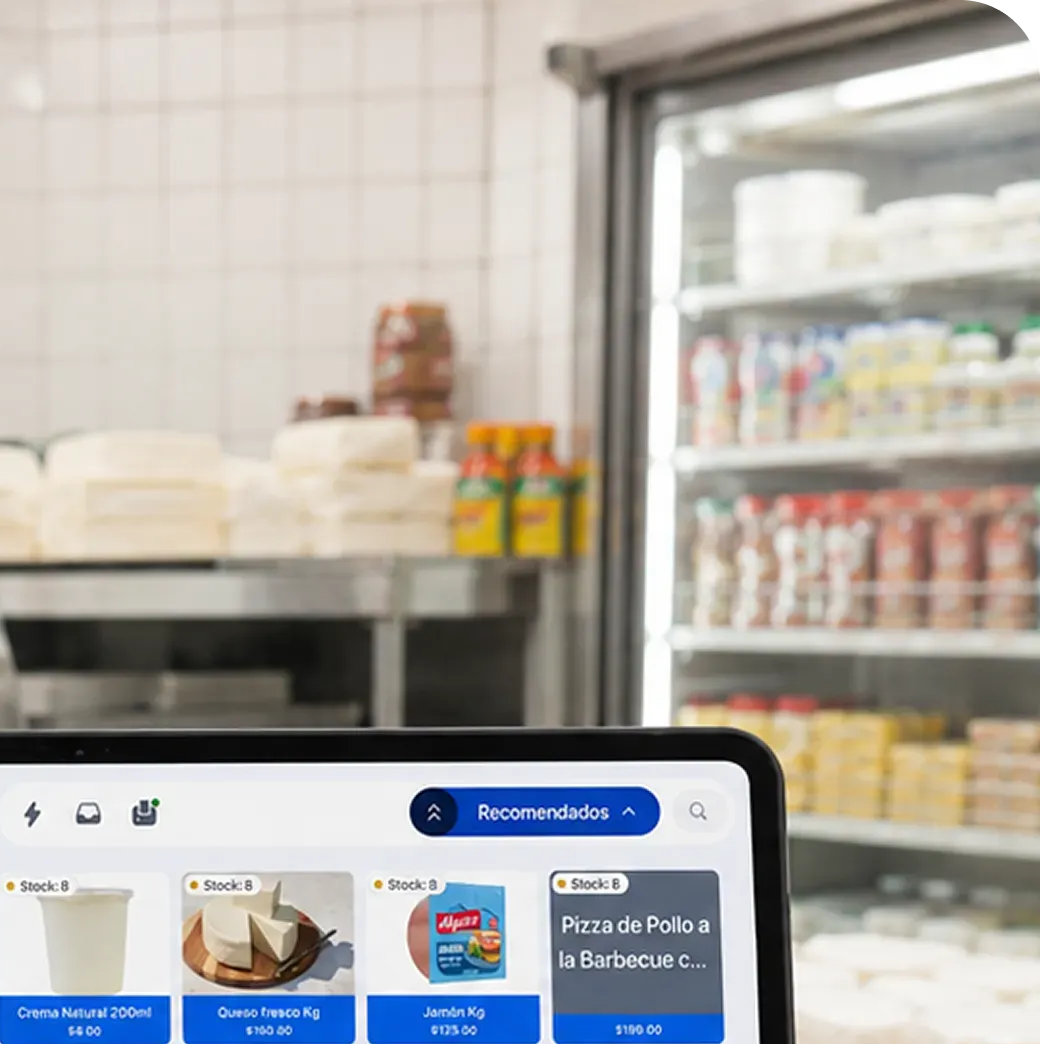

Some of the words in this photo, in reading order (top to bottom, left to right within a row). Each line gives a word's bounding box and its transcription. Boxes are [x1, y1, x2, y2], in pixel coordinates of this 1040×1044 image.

[477, 803, 610, 821] Recomendados
[19, 879, 59, 893] Stock:
[60, 879, 70, 893] 8
[203, 879, 243, 892] Stock:
[243, 879, 254, 892] 8
[387, 878, 427, 891] Stock:
[428, 878, 438, 892] 8
[570, 877, 610, 891] Stock:
[611, 877, 621, 891] 8
[561, 915, 614, 934] Pizza
[616, 915, 643, 934] de
[646, 914, 694, 934] Pollo
[697, 918, 710, 934] a
[558, 950, 576, 970] la
[579, 949, 675, 969] Barbecue
[677, 953, 707, 969] c...
[16, 1006, 60, 1020] Crema
[217, 1005, 259, 1019] Queso
[302, 1006, 321, 1021] Kg
[465, 1006, 486, 1021] Kg
